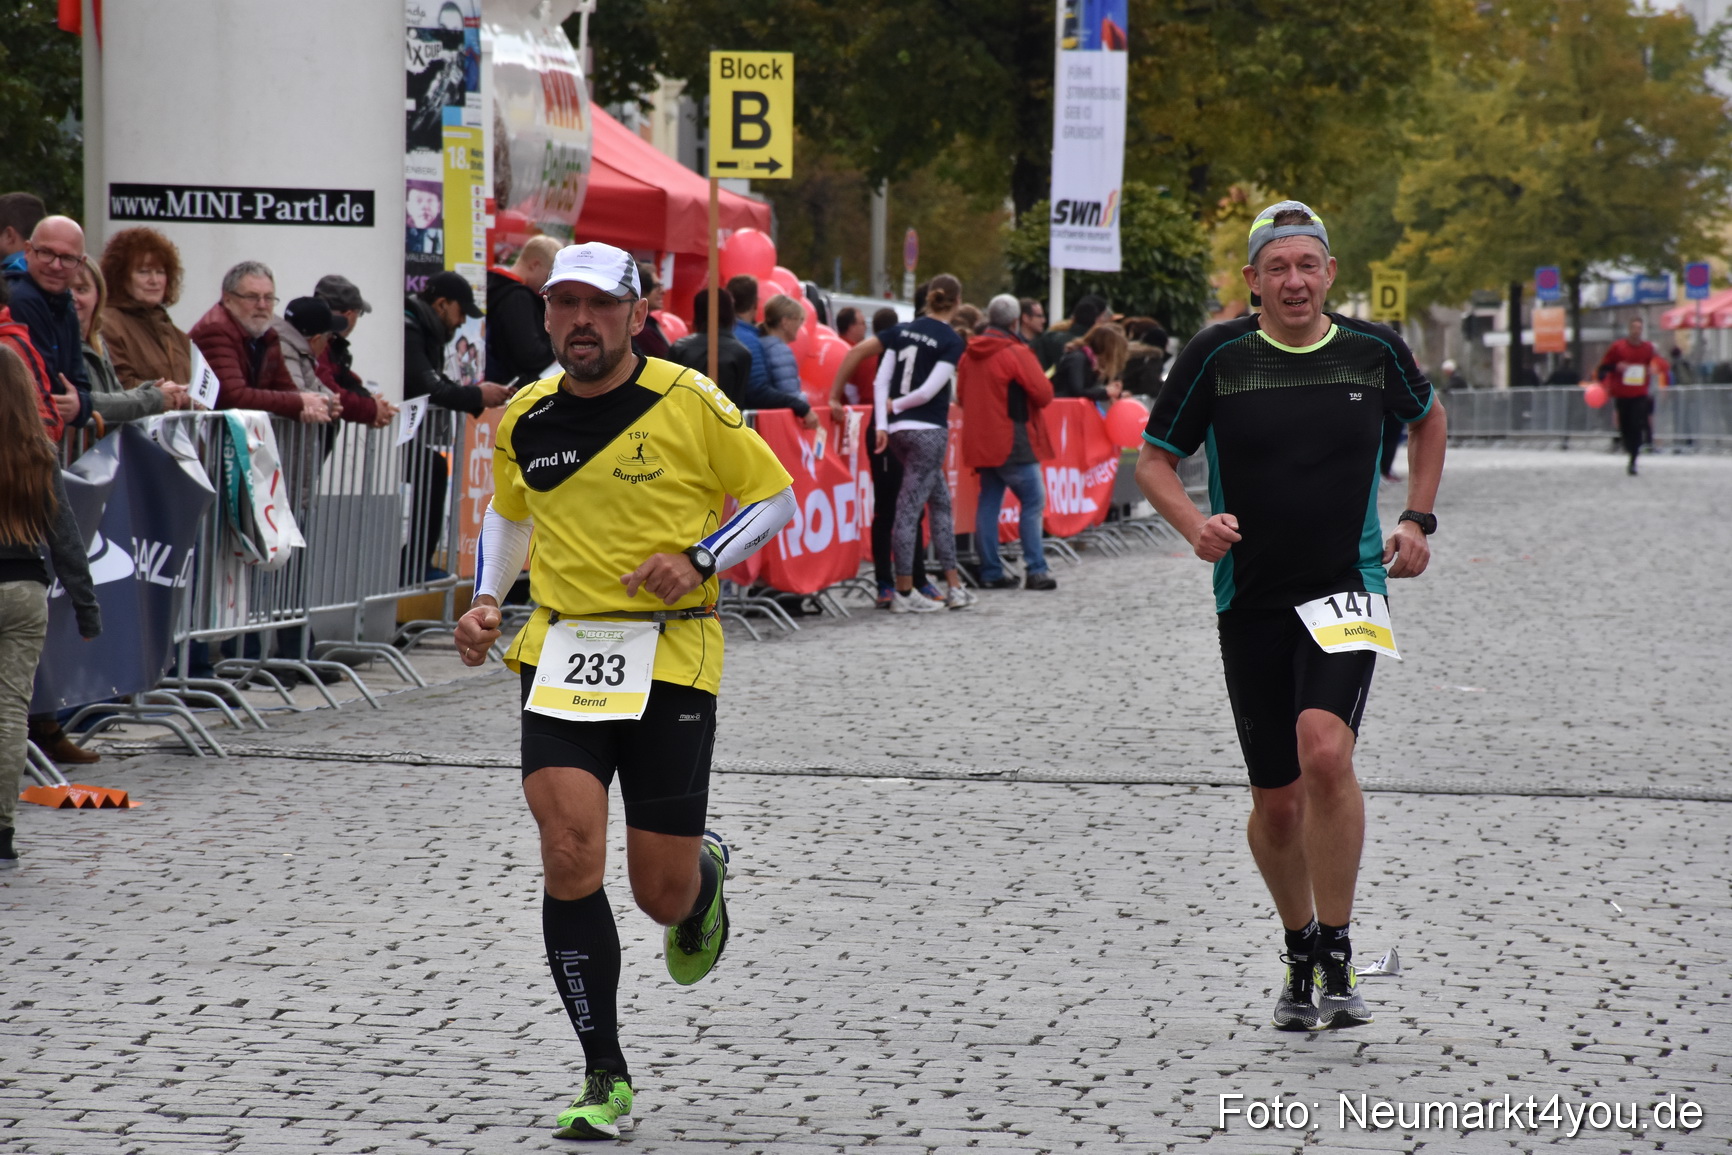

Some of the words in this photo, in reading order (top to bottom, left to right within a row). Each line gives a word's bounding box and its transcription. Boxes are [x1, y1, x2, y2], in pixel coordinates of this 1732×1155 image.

[720, 57, 783, 80] Block
[732, 90, 771, 149] B
[111, 190, 365, 222] www.MINI-Partl.de
[1381, 285, 1397, 309] D
[898, 345, 918, 396] 1
[627, 431, 649, 440] TSV
[562, 450, 580, 464] W.
[612, 467, 665, 485] Burgthann
[1324, 591, 1372, 619] 147
[586, 630, 625, 640] BOCK
[564, 653, 626, 687] 233
[572, 695, 608, 707] Bernd
[555, 950, 595, 1033] kalenji
